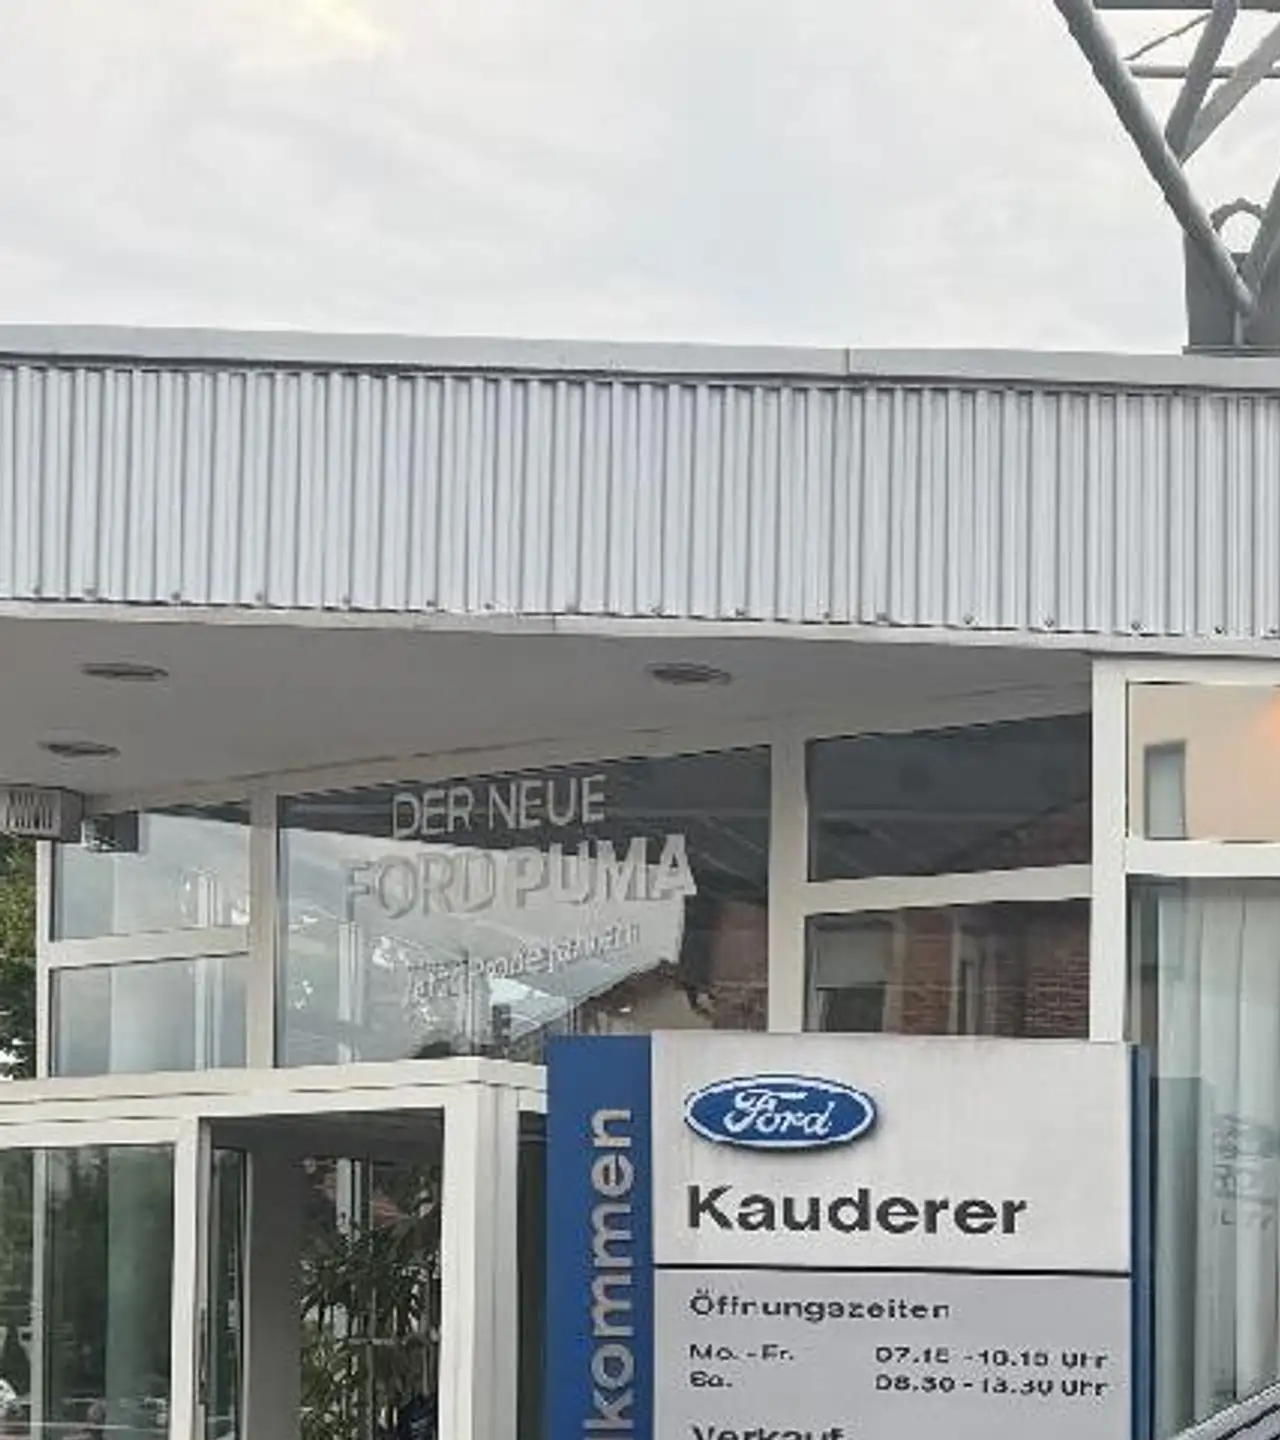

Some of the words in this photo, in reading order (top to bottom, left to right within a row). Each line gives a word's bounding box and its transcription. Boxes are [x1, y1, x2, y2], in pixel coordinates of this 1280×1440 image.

[391, 785, 474, 838] DER
[488, 774, 608, 832] NEUE
[345, 848, 496, 921] FORD
[503, 833, 698, 907] PUMA
[724, 1088, 833, 1138] Ford
[686, 1184, 1028, 1235] Kauderer
[689, 1289, 950, 1323] Öffnungszeiten
[1060, 1352, 1108, 1369] Uhr
[1061, 1379, 1108, 1396] Uhr
